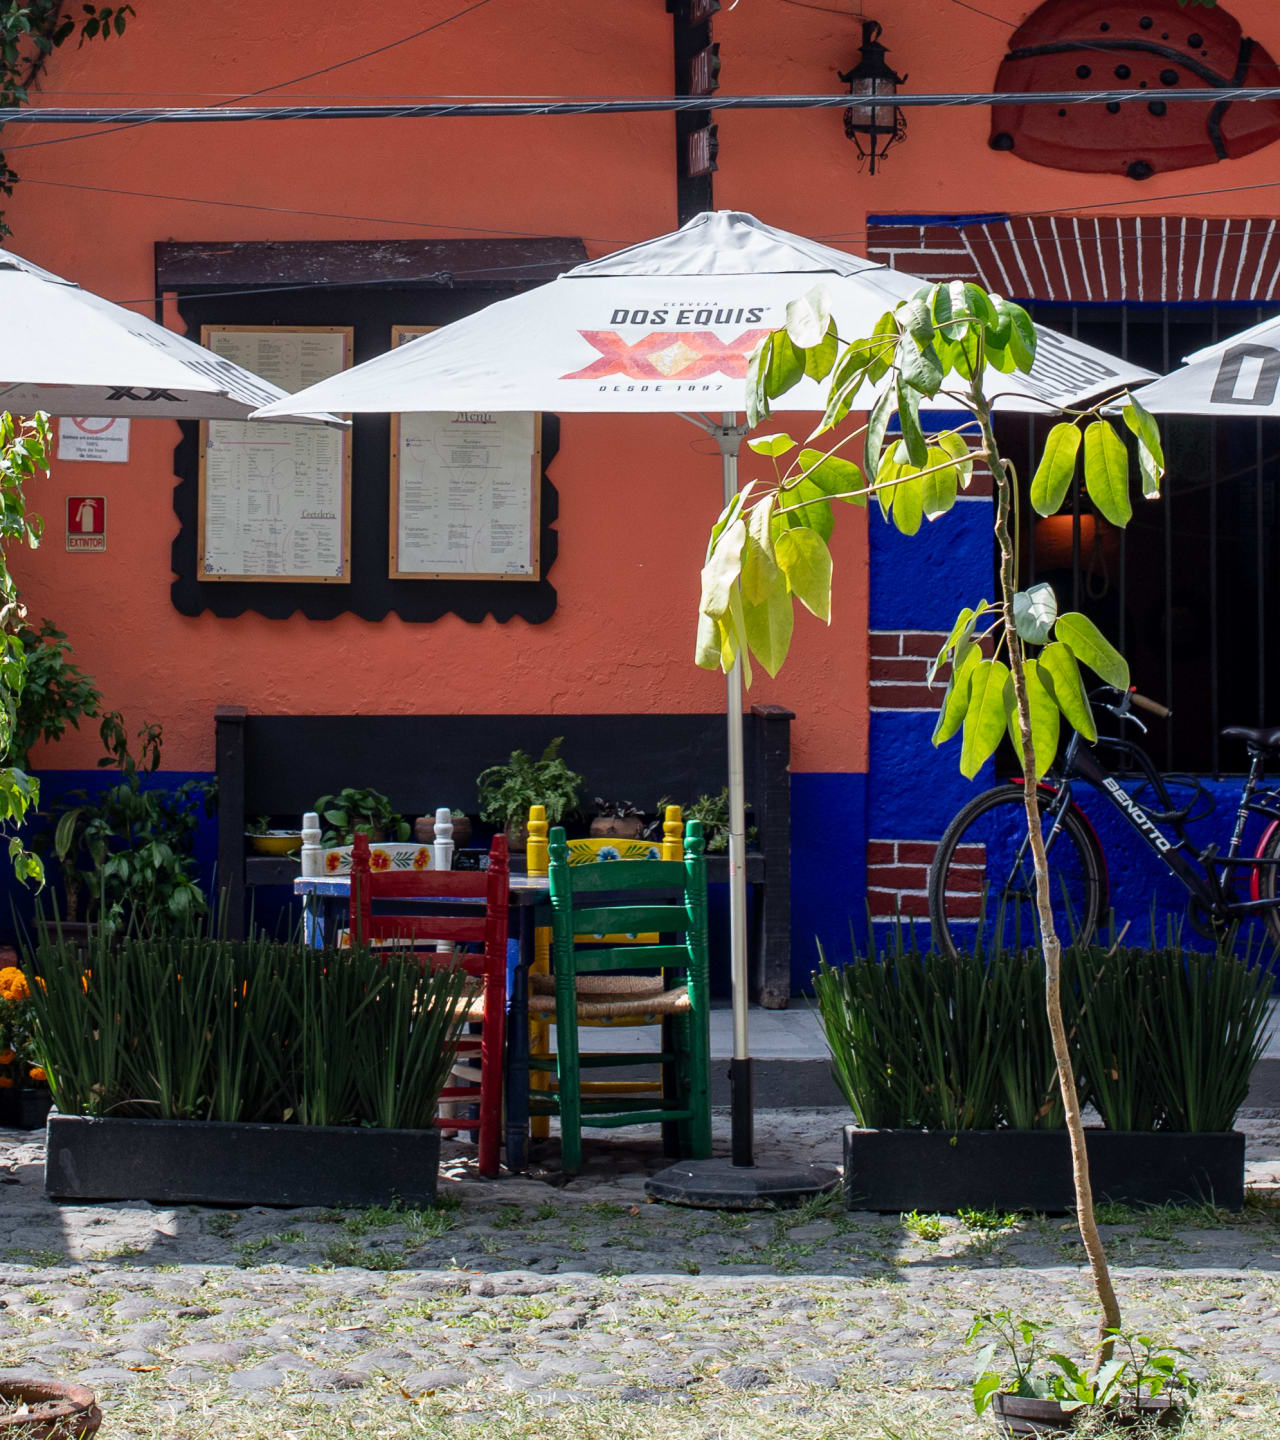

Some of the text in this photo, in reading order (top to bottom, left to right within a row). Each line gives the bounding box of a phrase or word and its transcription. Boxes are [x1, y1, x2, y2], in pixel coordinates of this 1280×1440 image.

[609, 306, 765, 326] DOS EQUIS
[69, 538, 103, 548] EXTINTOR
[1102, 777, 1172, 853] BENOTTO
